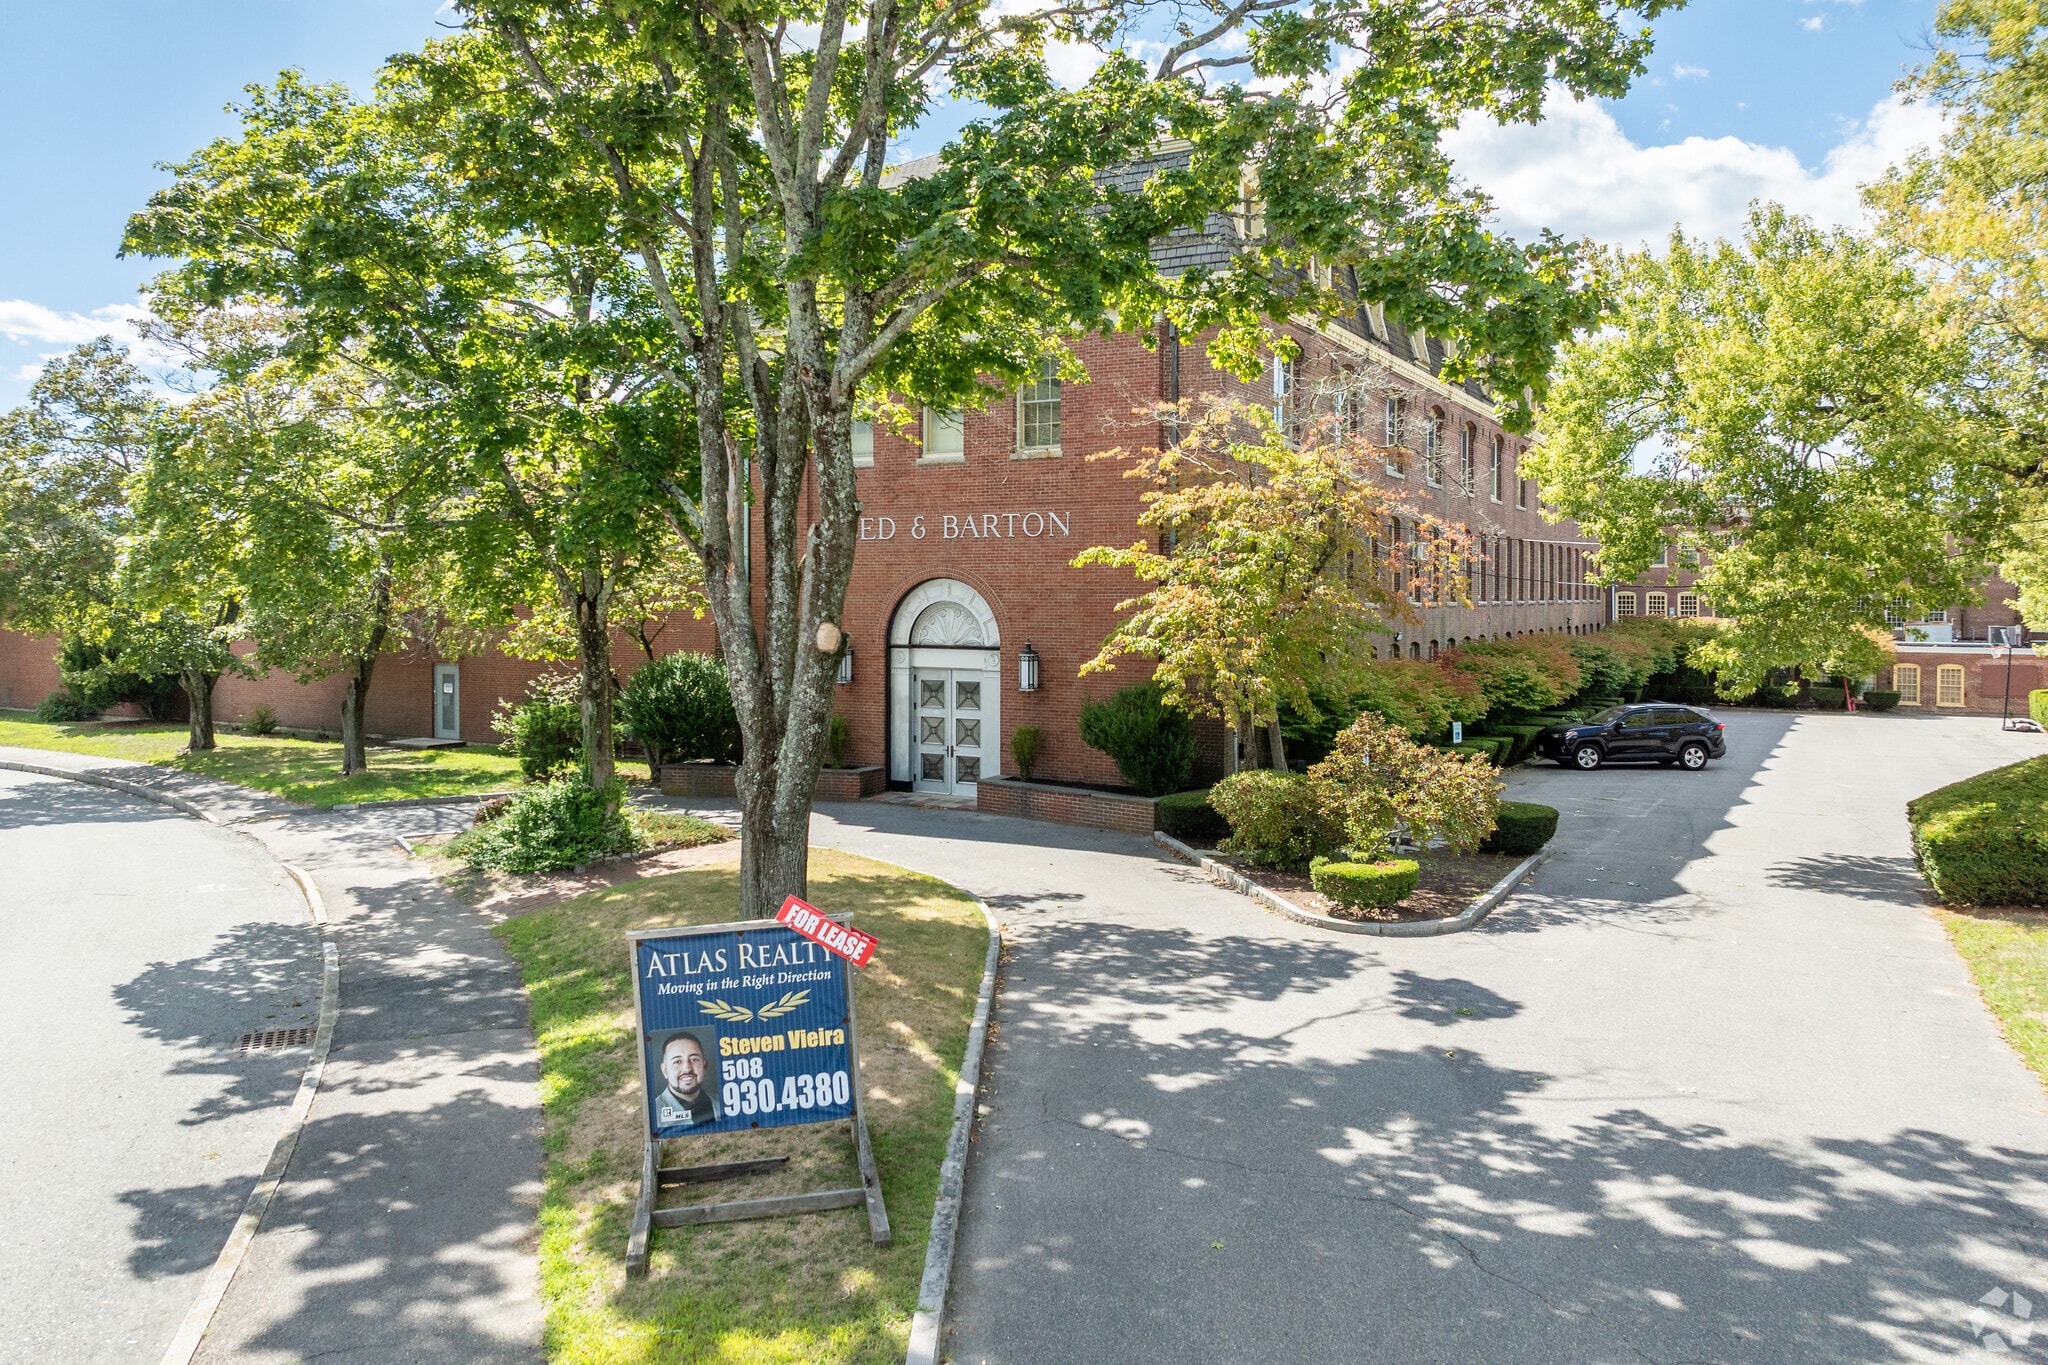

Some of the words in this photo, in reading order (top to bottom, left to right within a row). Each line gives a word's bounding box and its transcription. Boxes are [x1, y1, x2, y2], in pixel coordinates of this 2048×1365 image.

[860, 516, 897, 541] ED
[911, 515, 926, 540] &
[942, 511, 1071, 540] BARTON
[783, 903, 820, 935] FOR
[816, 922, 868, 961] LEASE
[646, 948, 728, 979] ATLAS
[657, 981, 703, 996] Moving
[706, 978, 718, 991] in
[721, 977, 739, 989] the
[742, 973, 774, 989] Right
[778, 968, 832, 984] Direction
[719, 1034, 785, 1057] Steven
[787, 1027, 845, 1050] Vieira
[722, 1057, 764, 1081] 508
[722, 1070, 850, 1117] 930.4380
